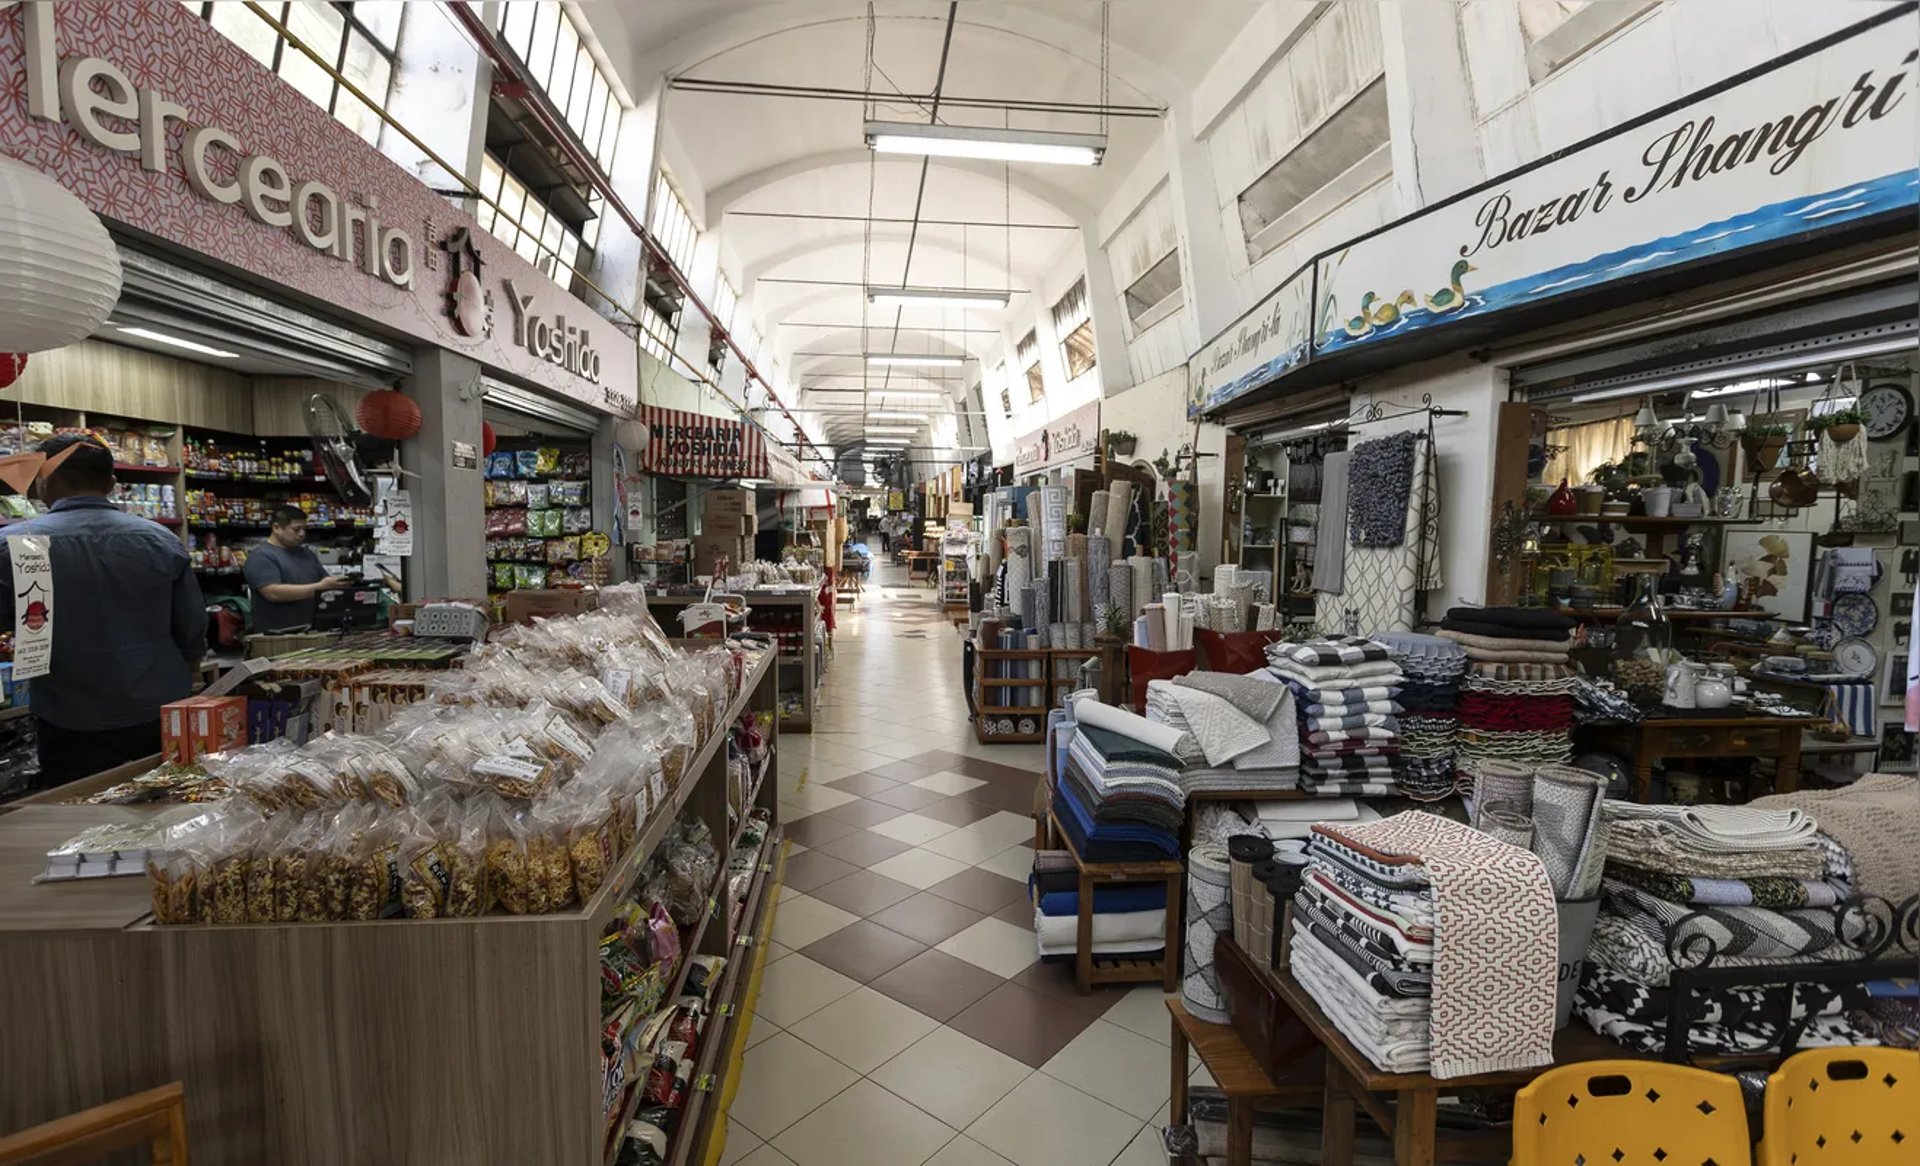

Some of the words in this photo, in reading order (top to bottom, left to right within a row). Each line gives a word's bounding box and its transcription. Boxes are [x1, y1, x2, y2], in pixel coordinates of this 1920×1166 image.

[1460, 171, 1613, 258] Bazar
[503, 279, 600, 385] Yoshida
[649, 424, 741, 442] MERCEARIA
[666, 440, 739, 456] YOSHIDA
